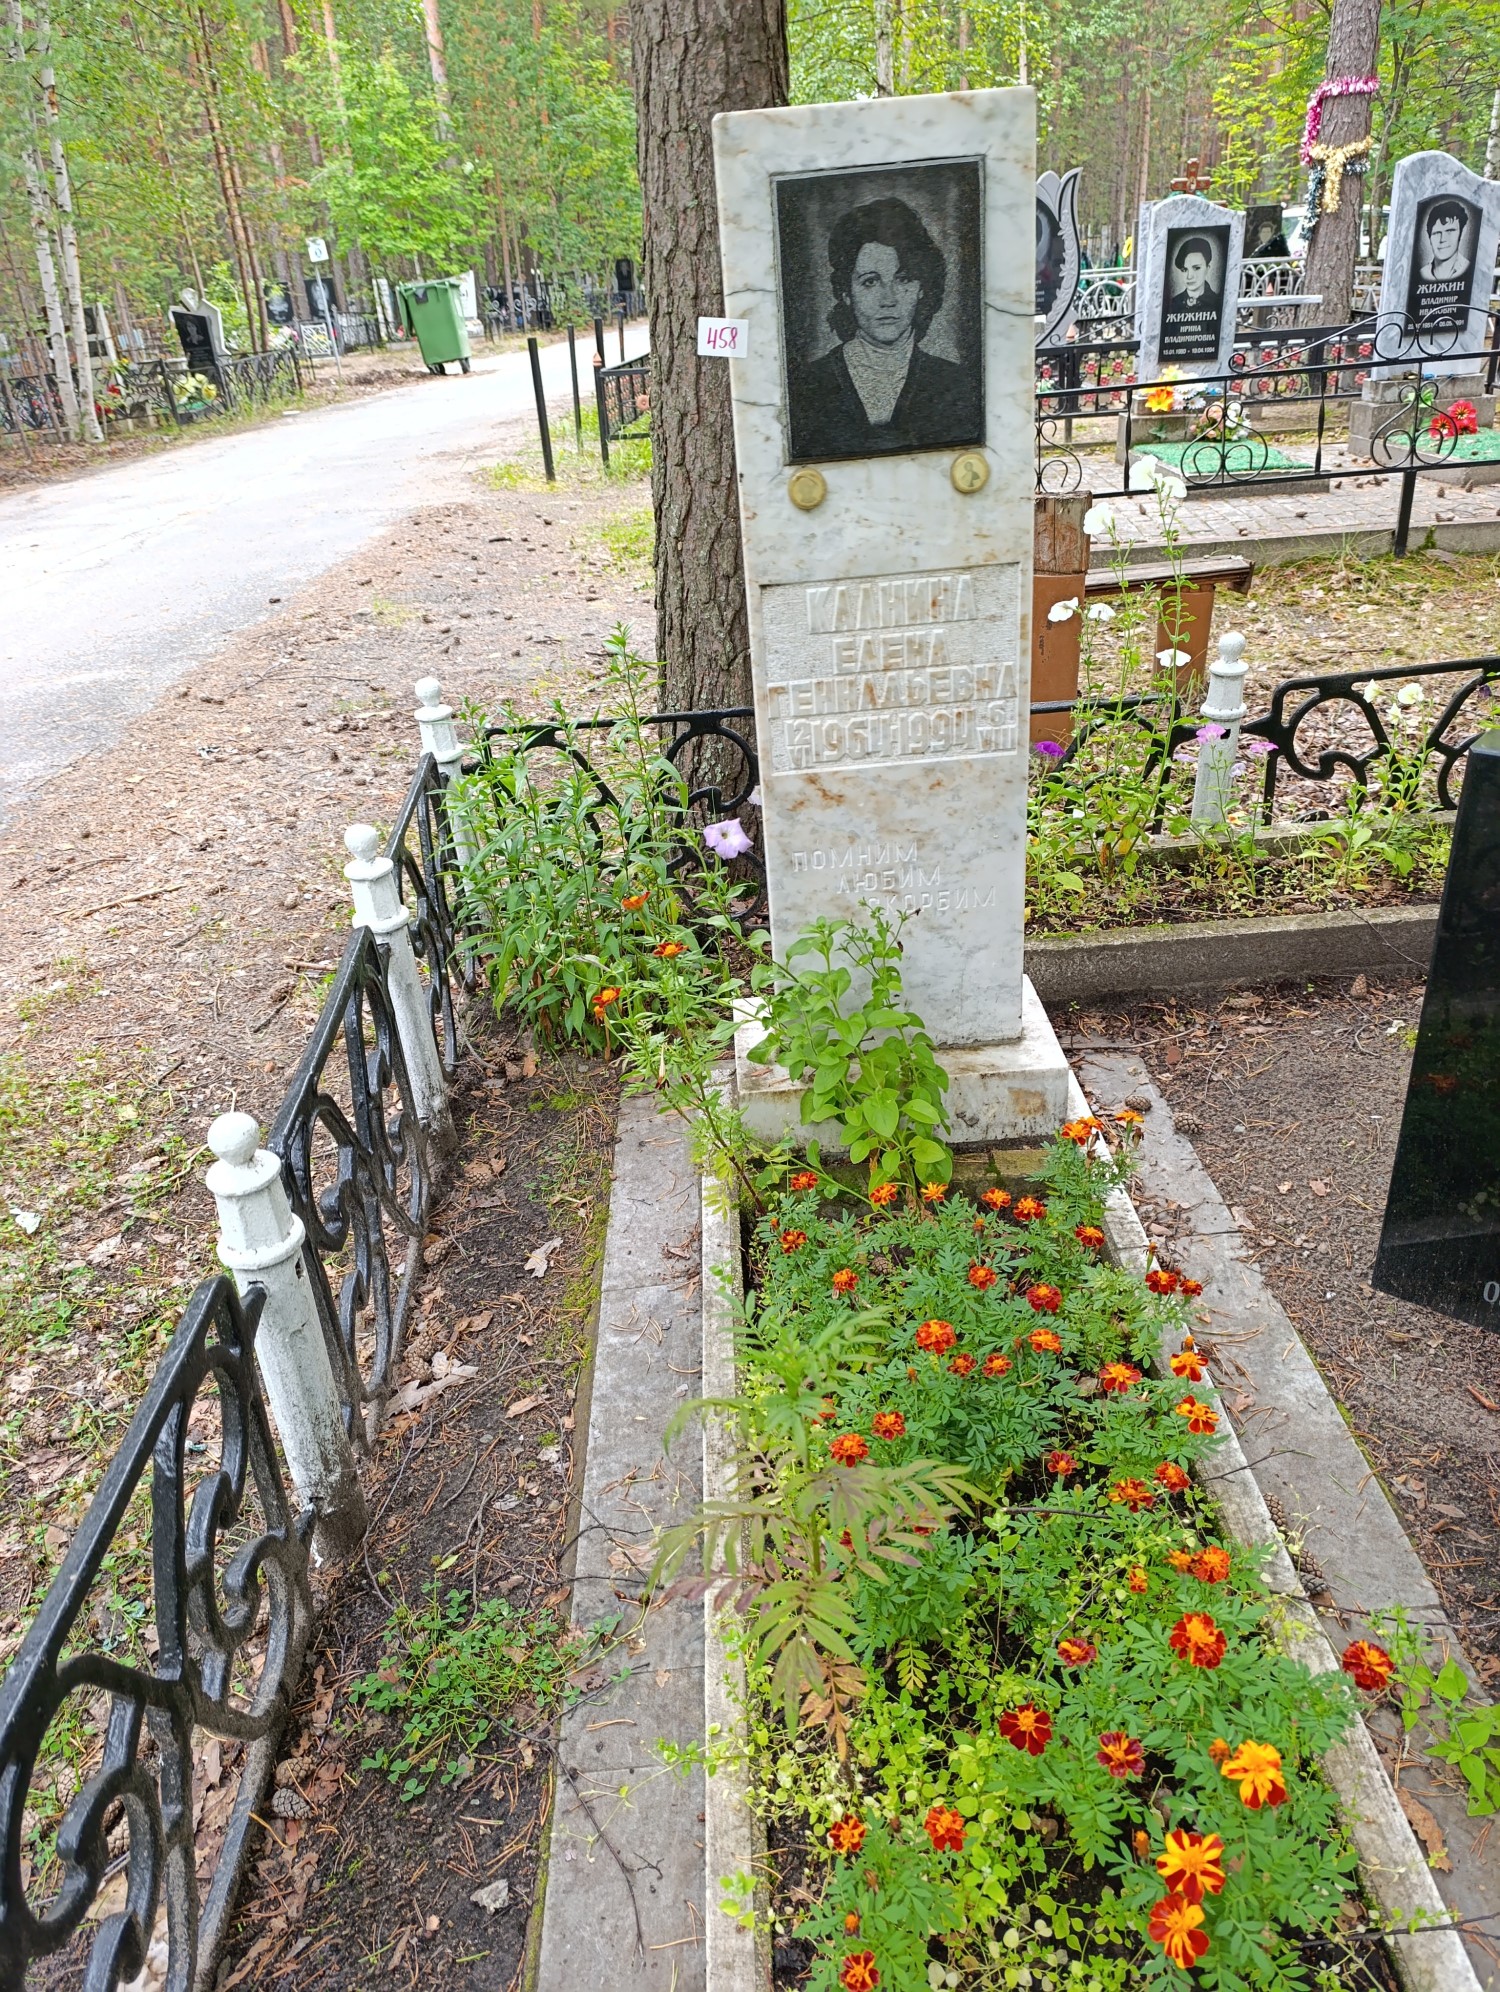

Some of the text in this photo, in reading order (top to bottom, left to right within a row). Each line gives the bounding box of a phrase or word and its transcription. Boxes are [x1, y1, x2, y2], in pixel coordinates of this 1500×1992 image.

[1416, 281, 1465, 294] ЖИЖИН
[1421, 295, 1459, 305] ВЛАДИМИР
[1166, 311, 1217, 323] ЖИЖИНА
[707, 326, 738, 349] 458
[1180, 324, 1201, 333] ИРИНА
[1164, 334, 1216, 343] ВЛАДИМИРОВНА
[833, 629, 949, 674] ЕЛЕНА
[766, 661, 1018, 718] ГЕННАДЬЕВНА
[791, 839, 919, 873] ПОМНИМ
[836, 865, 941, 895] ЛЮБИМ
